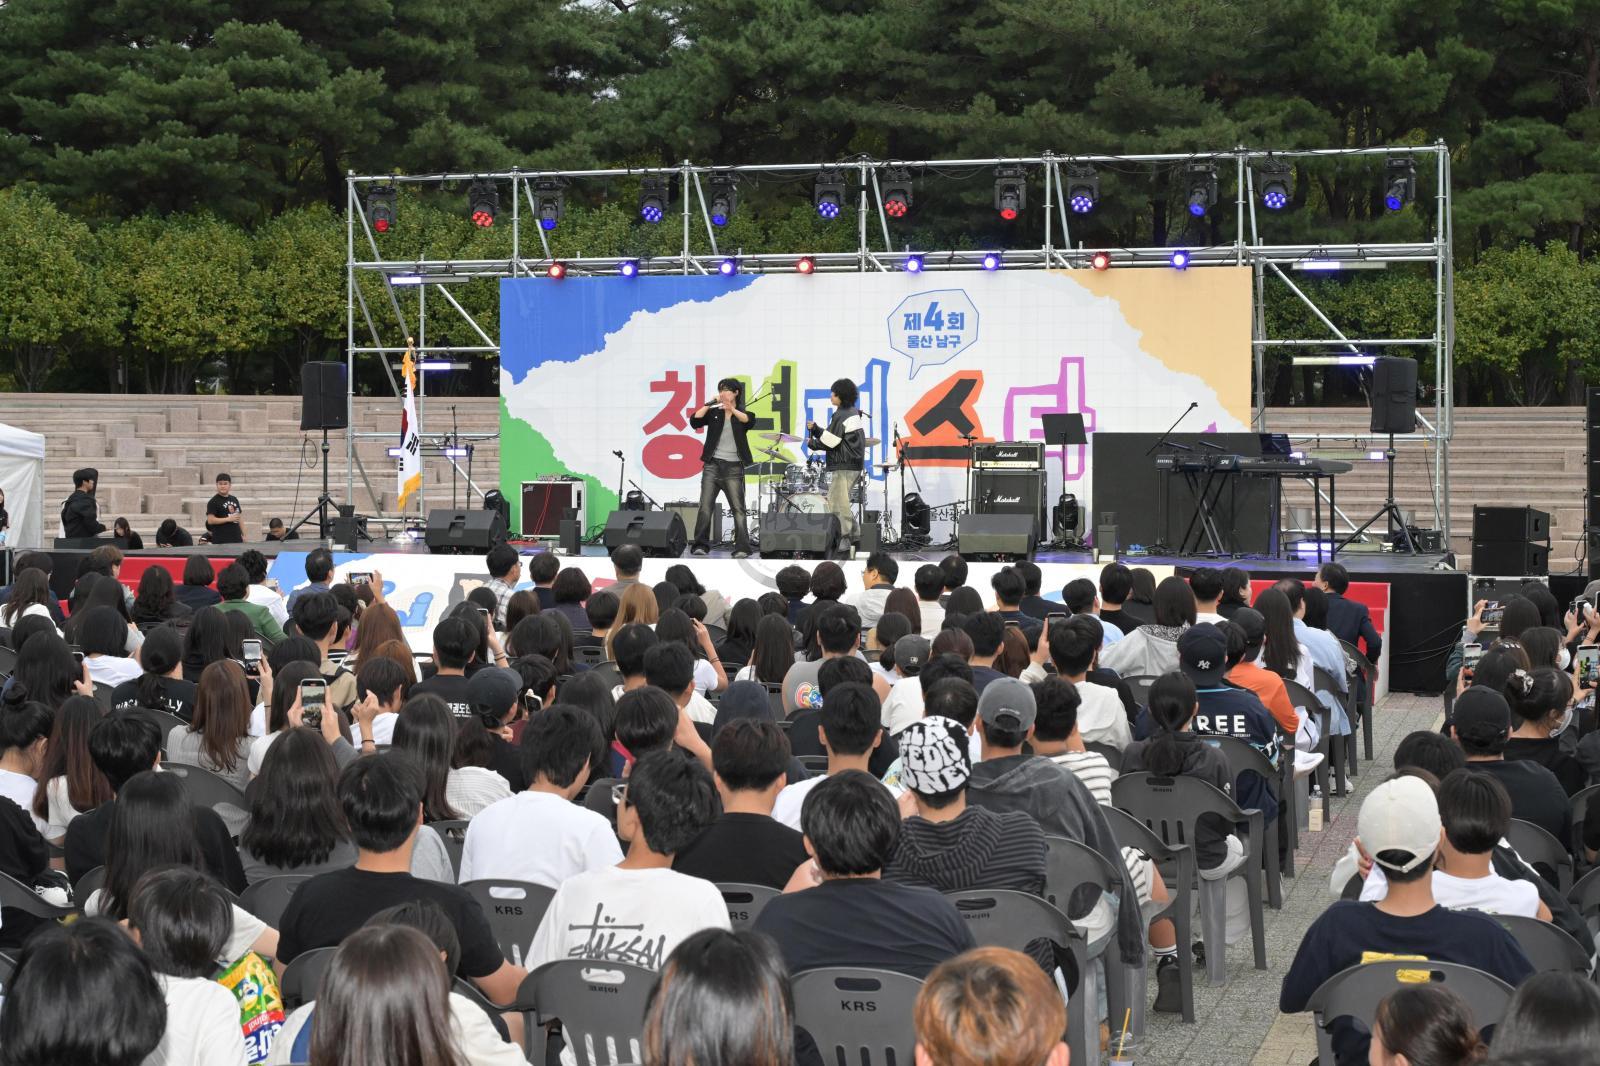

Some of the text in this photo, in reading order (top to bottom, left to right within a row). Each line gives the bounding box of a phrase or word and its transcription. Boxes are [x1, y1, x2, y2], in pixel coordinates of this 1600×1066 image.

[903, 301, 965, 332] 제4회
[907, 335, 961, 349] 울산 남구
[495, 904, 524, 916] KRS
[729, 911, 750, 921] RS
[840, 999, 878, 1012] KRS
